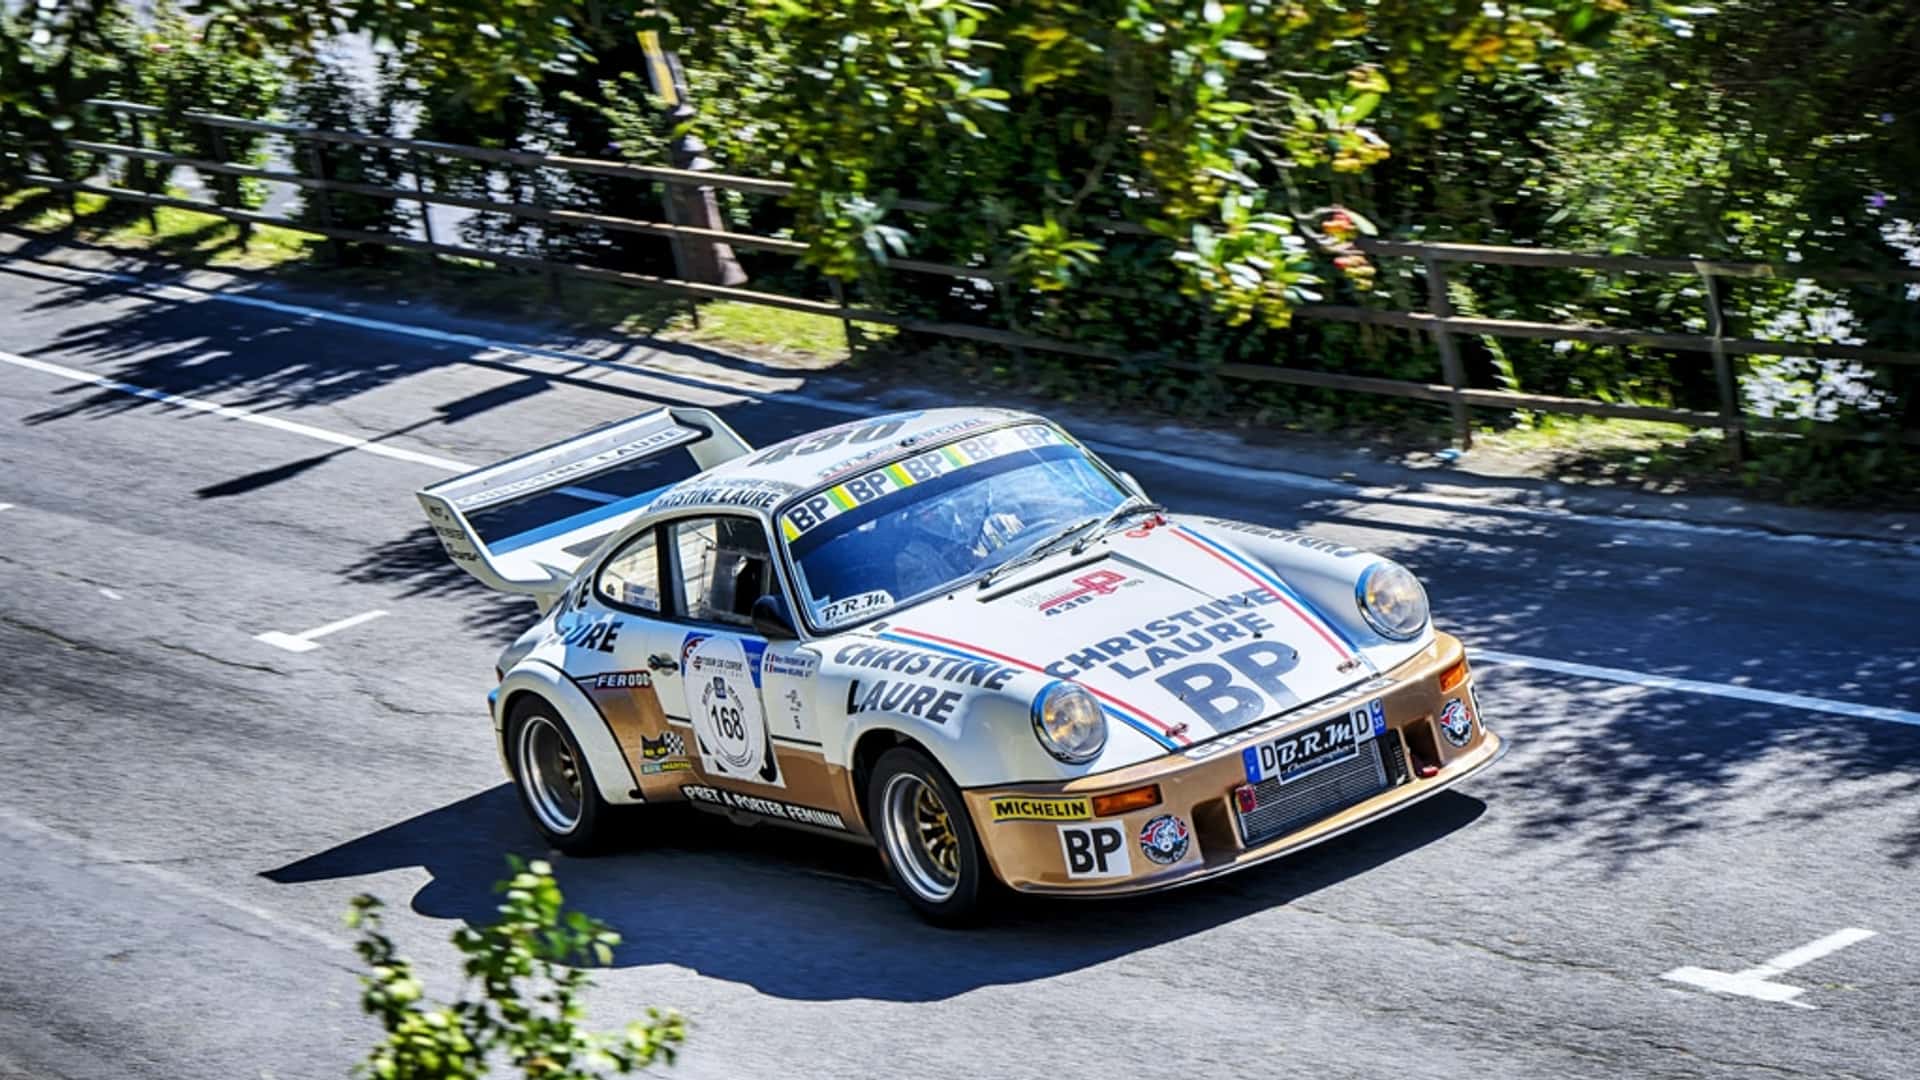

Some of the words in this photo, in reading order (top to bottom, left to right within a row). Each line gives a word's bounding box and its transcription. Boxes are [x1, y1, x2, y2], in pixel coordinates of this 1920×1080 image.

[960, 438, 1000, 461] BP
[1013, 425, 1051, 447] BP
[903, 451, 944, 483] BP
[719, 488, 781, 508] LAURE
[847, 472, 888, 503] BP
[788, 496, 830, 532] BP
[822, 593, 887, 622] B.R.M
[1043, 587, 1281, 679] CHRISTINE
[1108, 612, 1275, 679] LAURE
[834, 643, 1020, 691] CHRISTINE
[847, 680, 963, 725] LAURE
[1155, 641, 1301, 734] BP
[711, 704, 745, 741] 168
[1277, 721, 1354, 765] B.R.M
[734, 795, 787, 819] PORTER
[996, 800, 1087, 817] MICHELIN
[1063, 827, 1122, 873] BP
